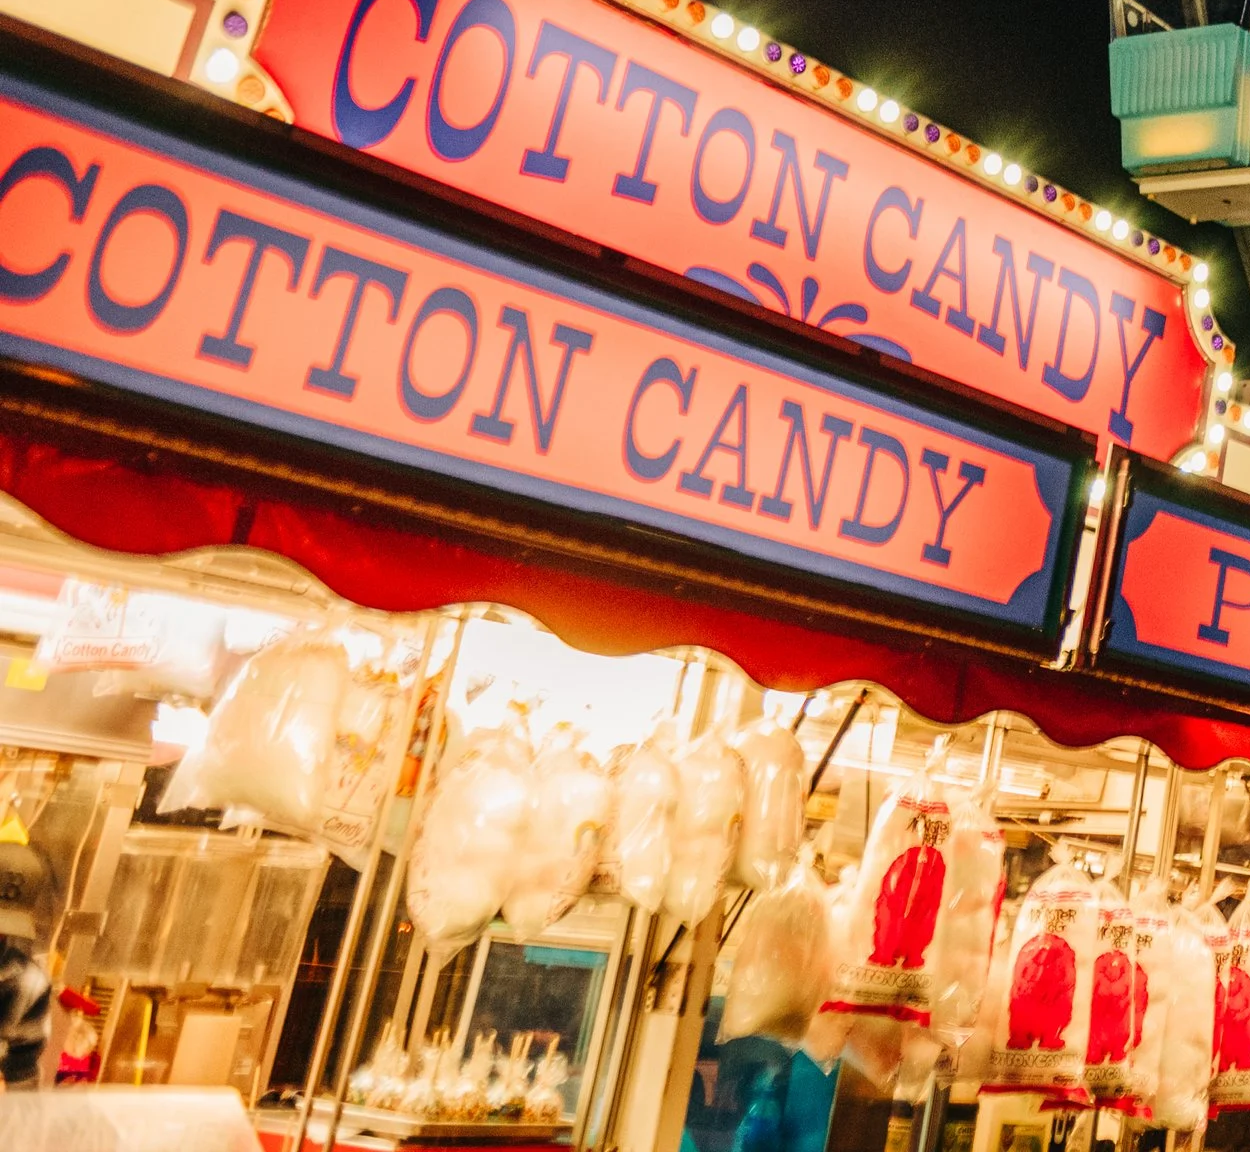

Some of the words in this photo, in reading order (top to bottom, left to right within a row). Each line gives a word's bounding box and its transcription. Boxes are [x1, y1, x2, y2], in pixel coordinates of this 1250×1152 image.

[0, 145, 593, 457] COTTON
[622, 356, 986, 569] CANDY
[863, 185, 1167, 447] CANDY
[62, 641, 107, 658] Cotton
[111, 641, 151, 660] Candy
